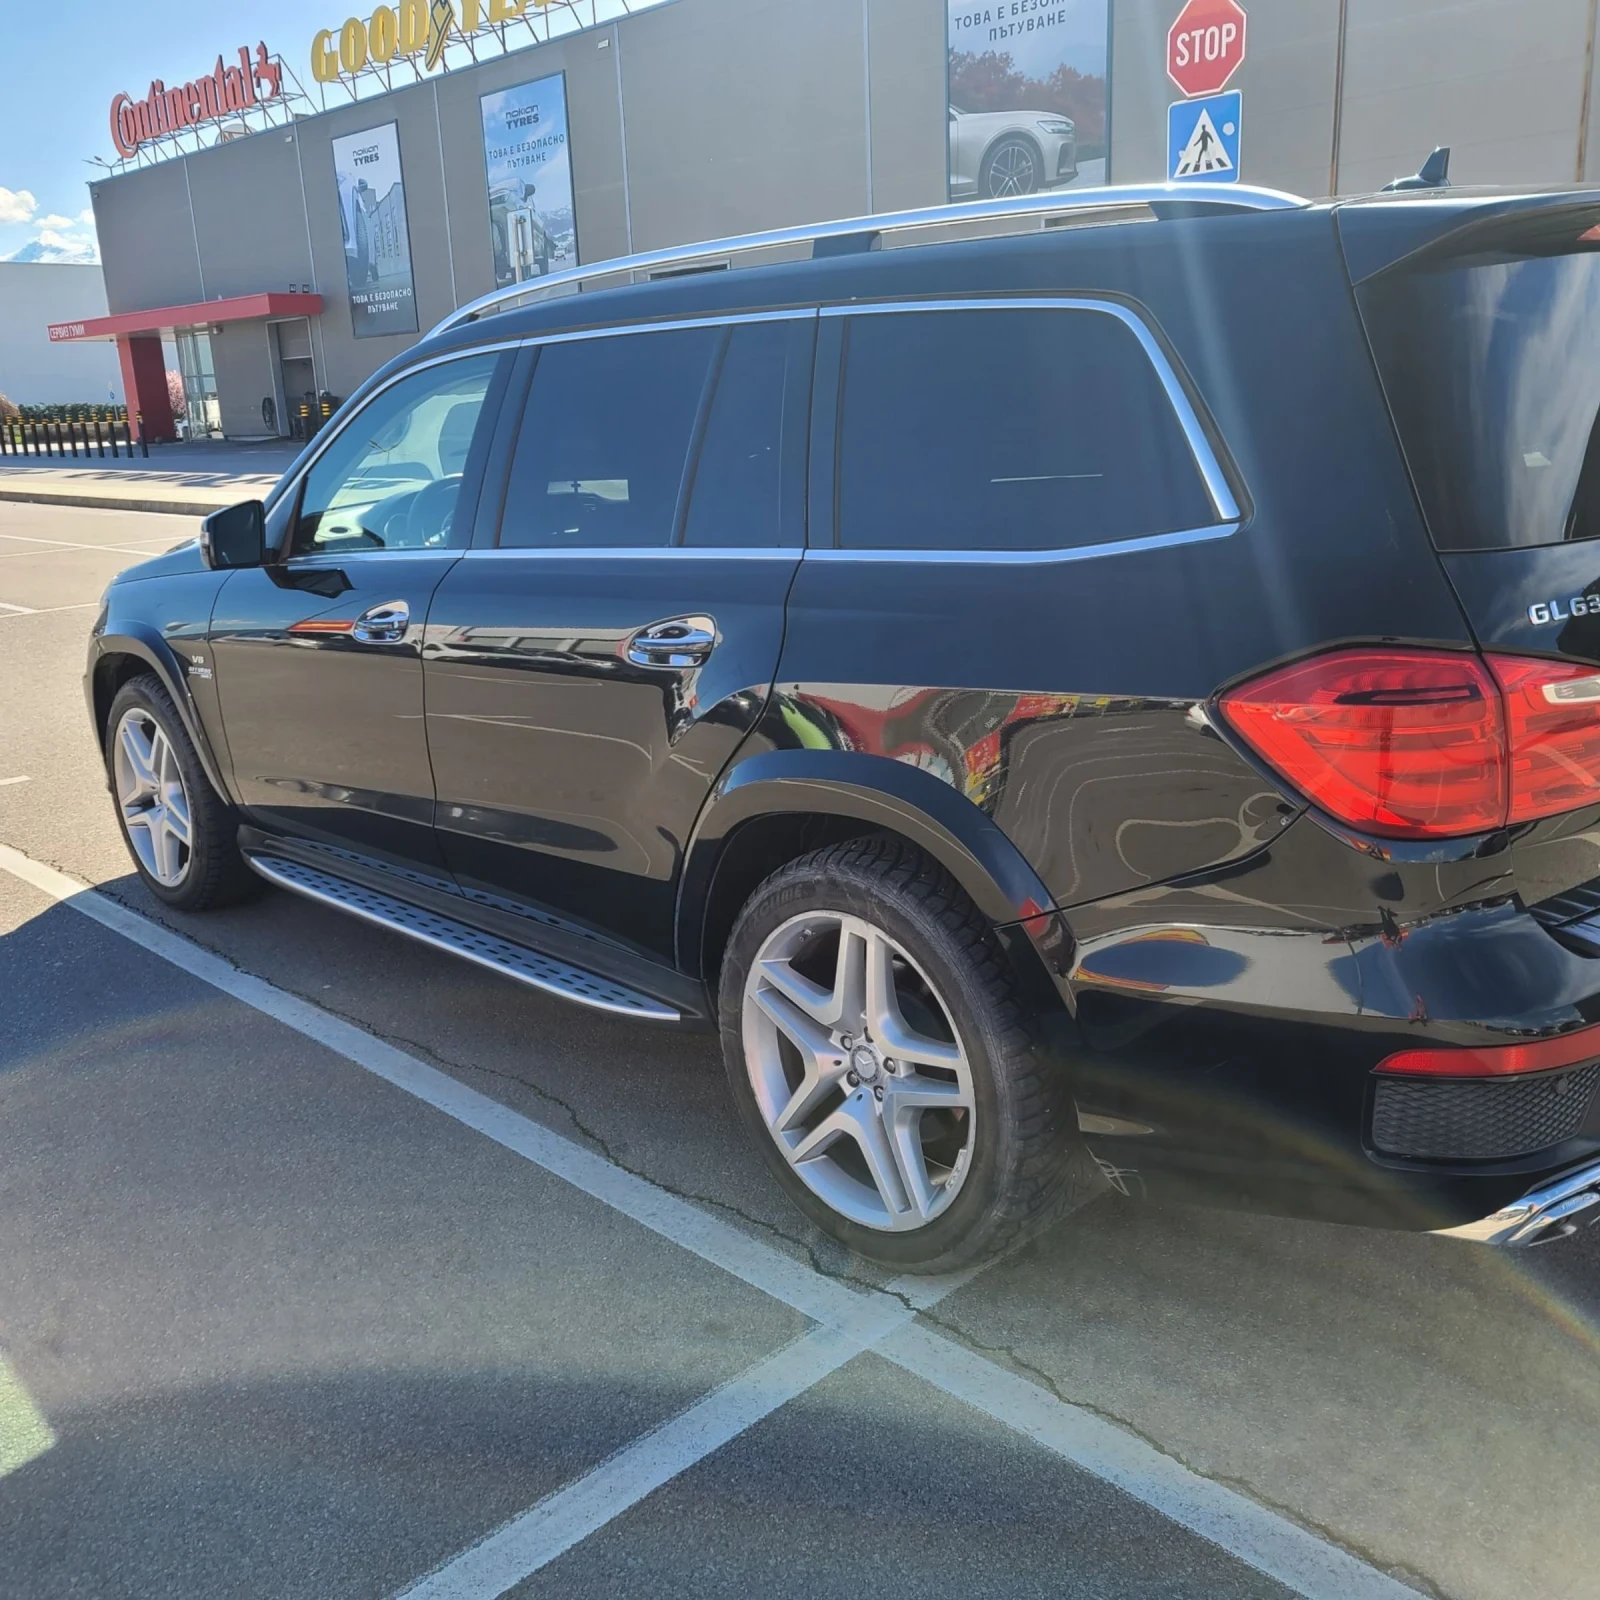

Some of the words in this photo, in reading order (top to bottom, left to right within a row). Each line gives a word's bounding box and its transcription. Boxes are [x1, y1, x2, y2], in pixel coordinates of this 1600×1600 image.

[955, 10, 991, 30] ТОВА
[997, 6, 1005, 20] Е
[989, 10, 1066, 41] ПЪТУВАНЕ
[1176, 23, 1236, 67] STOP
[110, 45, 258, 158] Continental
[506, 113, 539, 130] TYRES
[488, 148, 508, 160] ТОВА
[510, 145, 514, 155] Е
[516, 133, 565, 153] БЕЗОПАСНО
[353, 153, 380, 166] TYRES
[507, 152, 547, 169] ПЪТУВАНЕ
[352, 295, 368, 304] ТОВА
[369, 293, 374, 302] Е
[375, 287, 412, 301] БЕЗОПАСНО
[367, 301, 399, 314] ПЪТУВАНЕ
